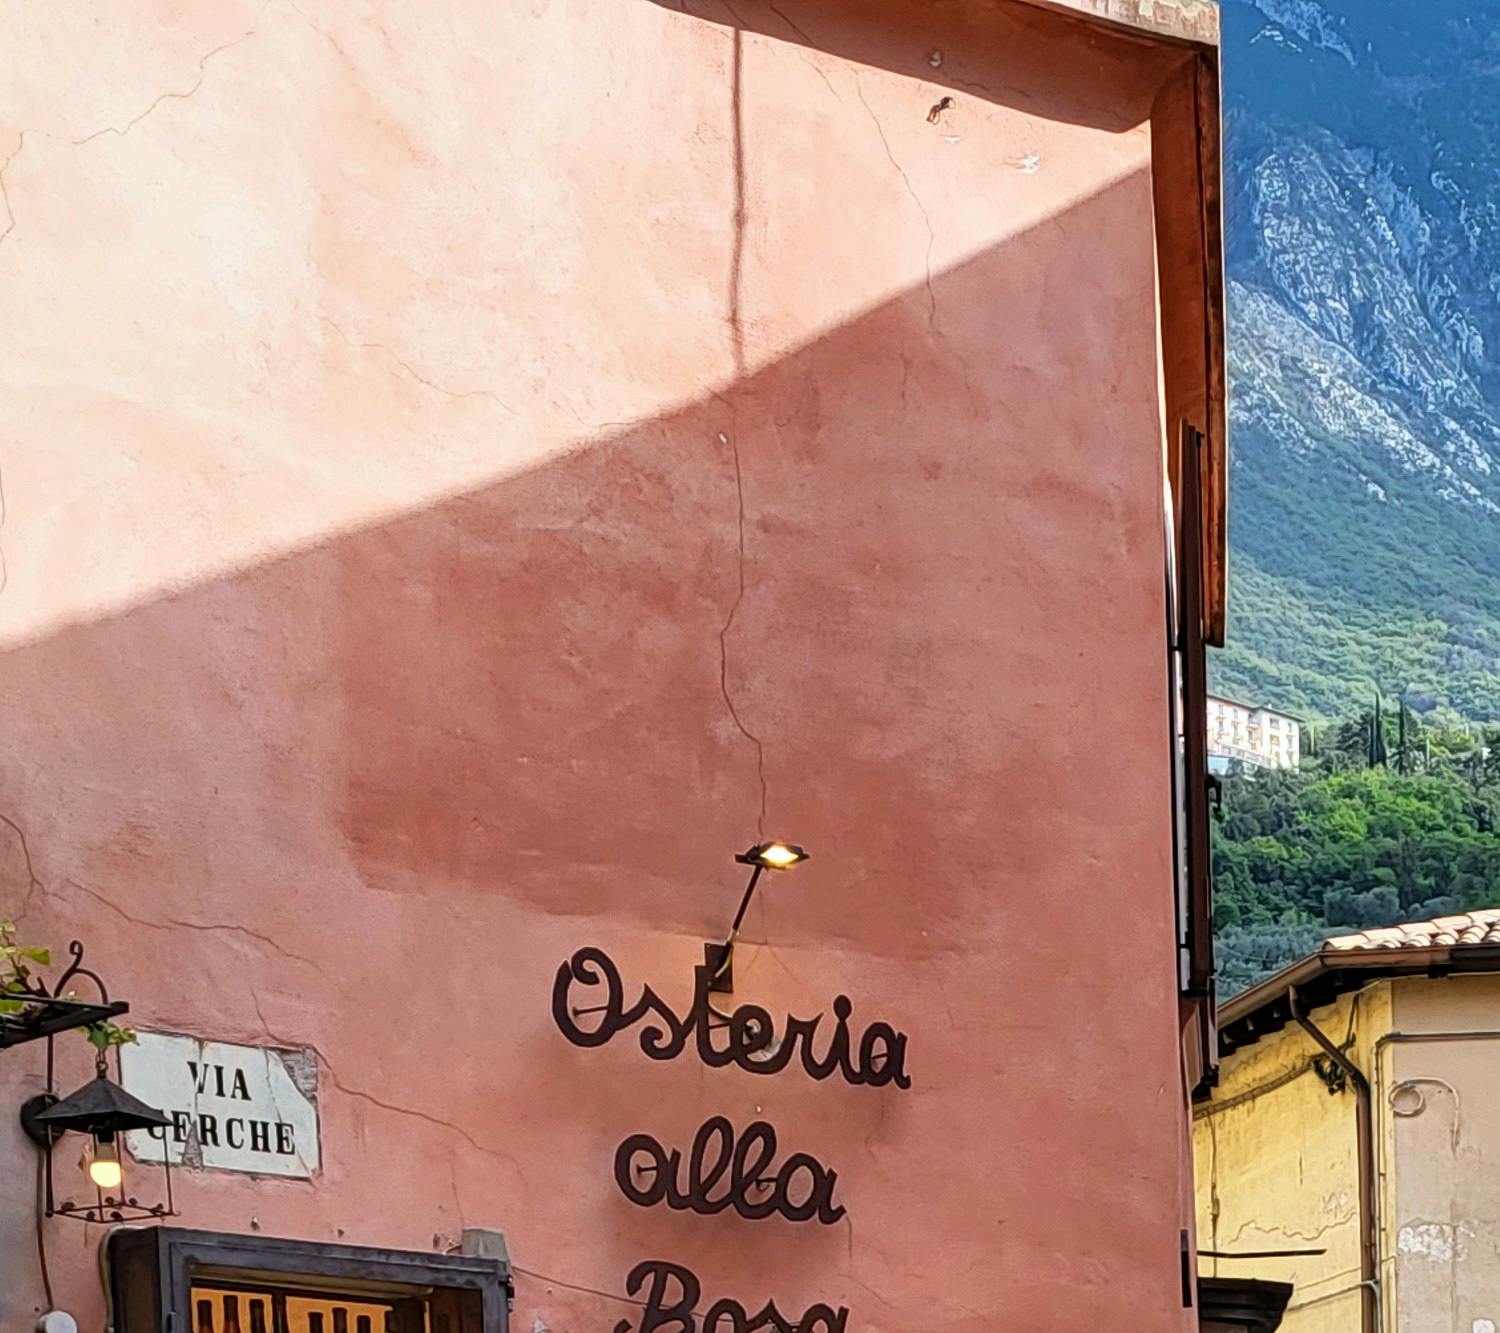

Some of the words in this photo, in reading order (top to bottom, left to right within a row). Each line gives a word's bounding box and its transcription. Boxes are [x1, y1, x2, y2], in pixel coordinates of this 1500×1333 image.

[552, 947, 911, 1089] Osteria
[187, 1061, 252, 1102] VIA
[614, 1115, 847, 1225] alla
